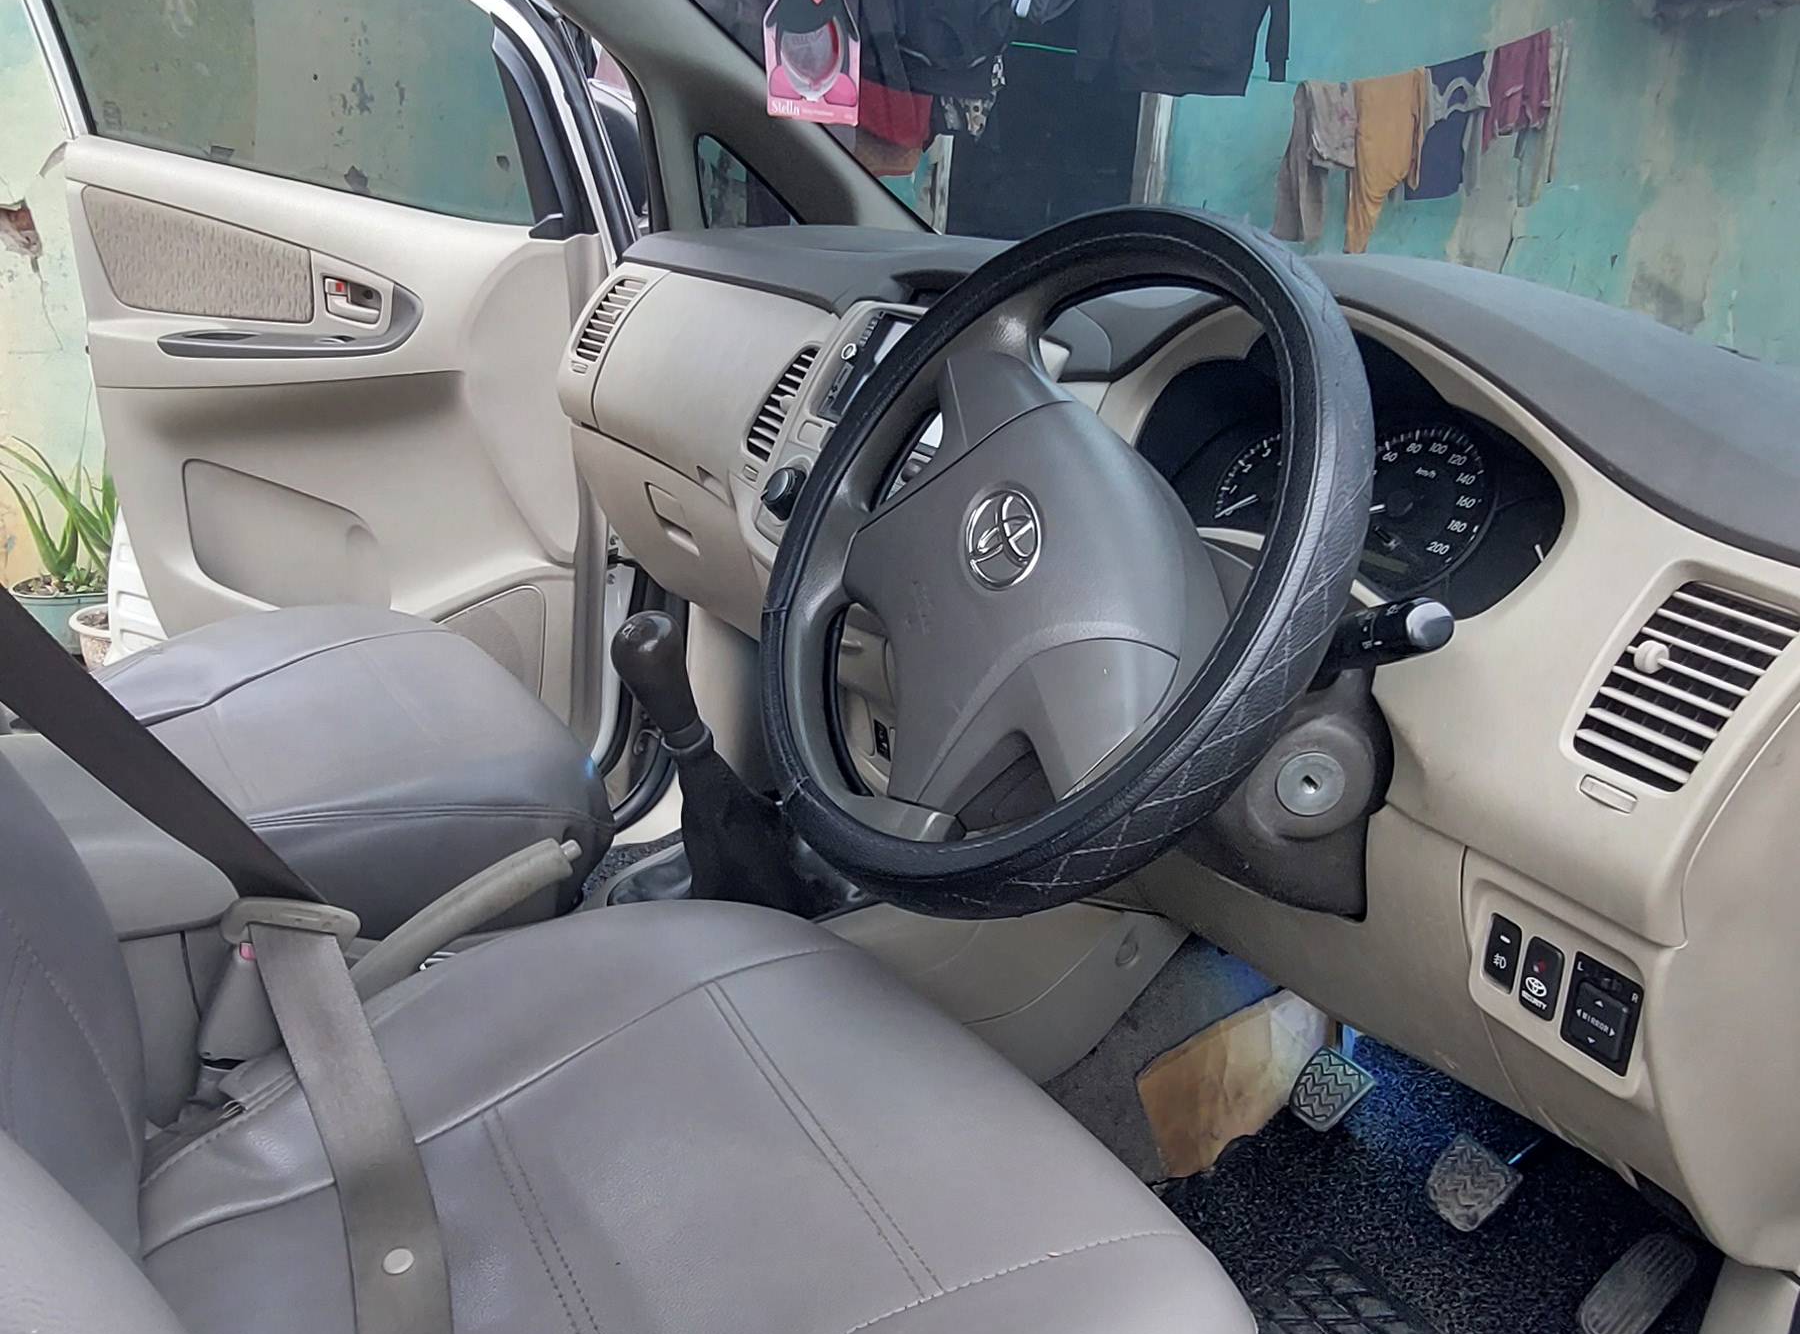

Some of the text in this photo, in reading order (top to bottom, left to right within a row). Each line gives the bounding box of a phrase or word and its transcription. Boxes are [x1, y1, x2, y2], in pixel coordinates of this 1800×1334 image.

[1406, 442, 1422, 454] 80
[1428, 442, 1448, 454] 100
[1382, 451, 1398, 462] 60
[1448, 453, 1467, 466] 120
[1415, 467, 1436, 479] km/h
[1456, 473, 1476, 485] 140
[1456, 495, 1476, 508] 160
[1447, 519, 1467, 533] 180
[1426, 541, 1450, 555] 200
[1577, 961, 1584, 972] L
[1631, 992, 1639, 1003] R
[1582, 1011, 1609, 1033] MIRROR
